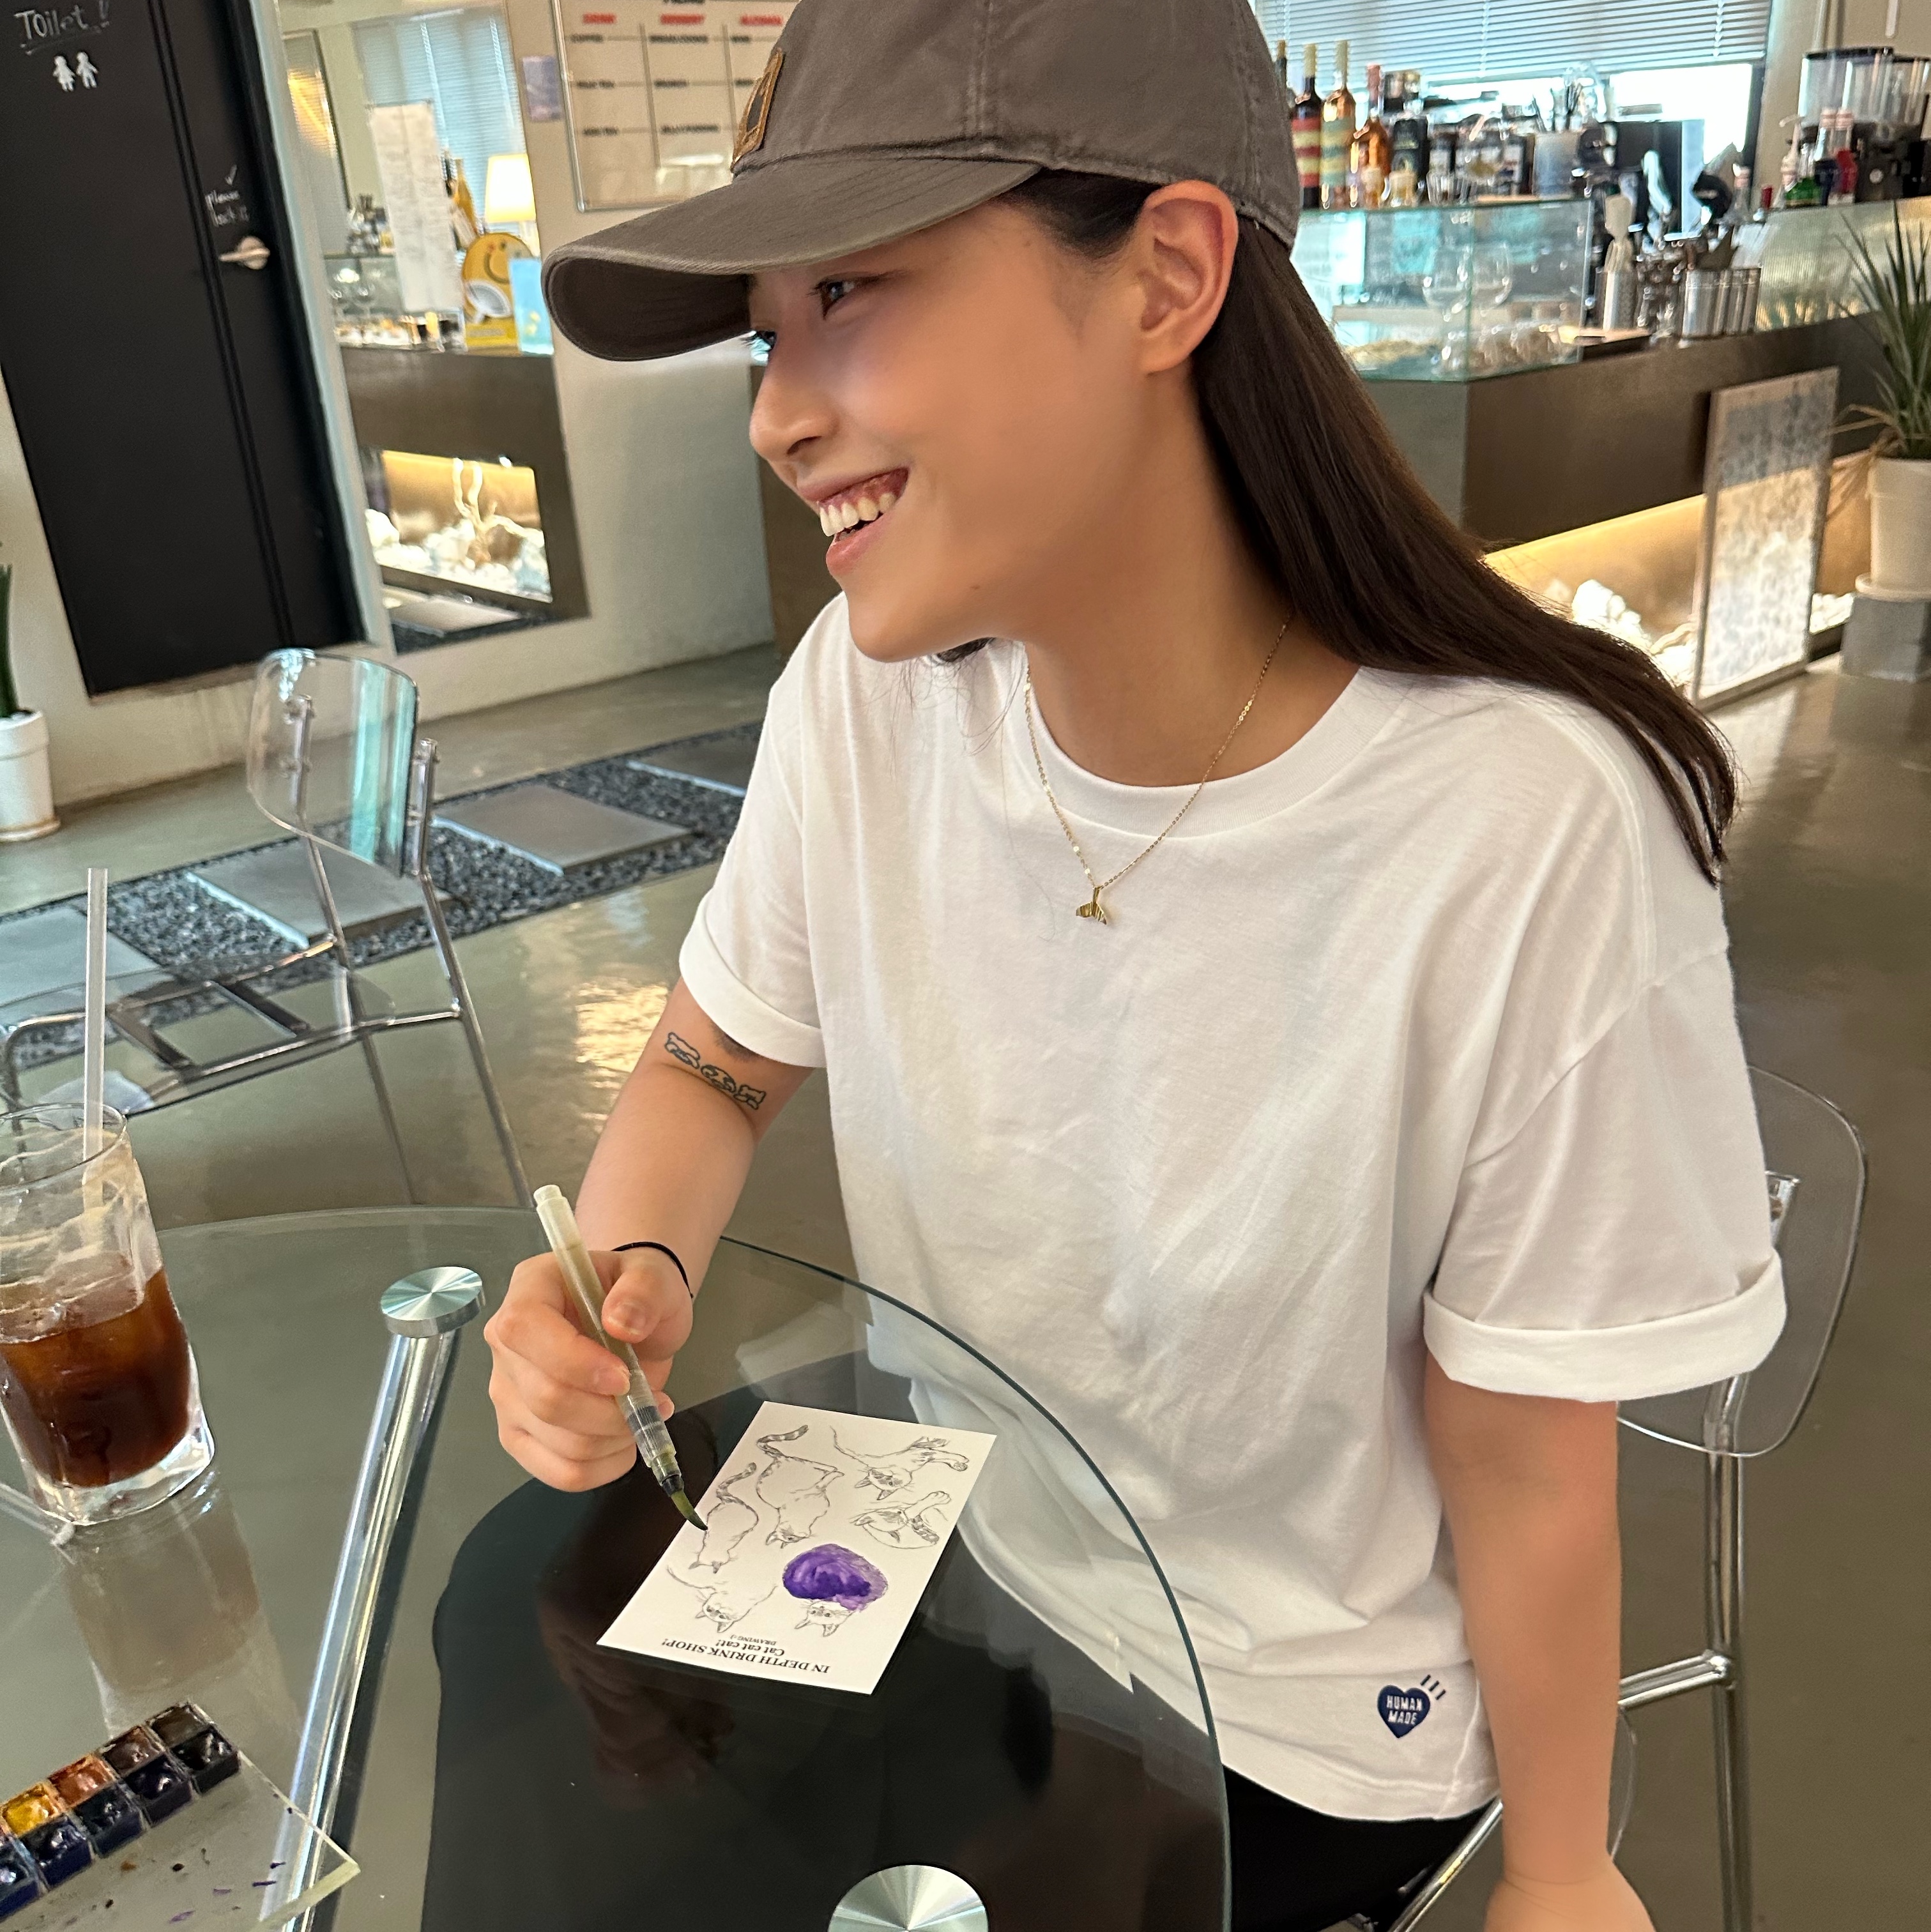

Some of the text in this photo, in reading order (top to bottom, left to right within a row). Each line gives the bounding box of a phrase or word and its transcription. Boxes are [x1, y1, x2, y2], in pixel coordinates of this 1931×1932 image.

[715, 1639, 740, 1647] cat!
[737, 1636, 777, 1646] DRAWING
[661, 1638, 830, 1673] IN DEPTH DRINK SHOP!
[766, 1647, 785, 1656] Cat
[1386, 1695, 1423, 1712] HUMAN
[1387, 1710, 1417, 1725] MADE
